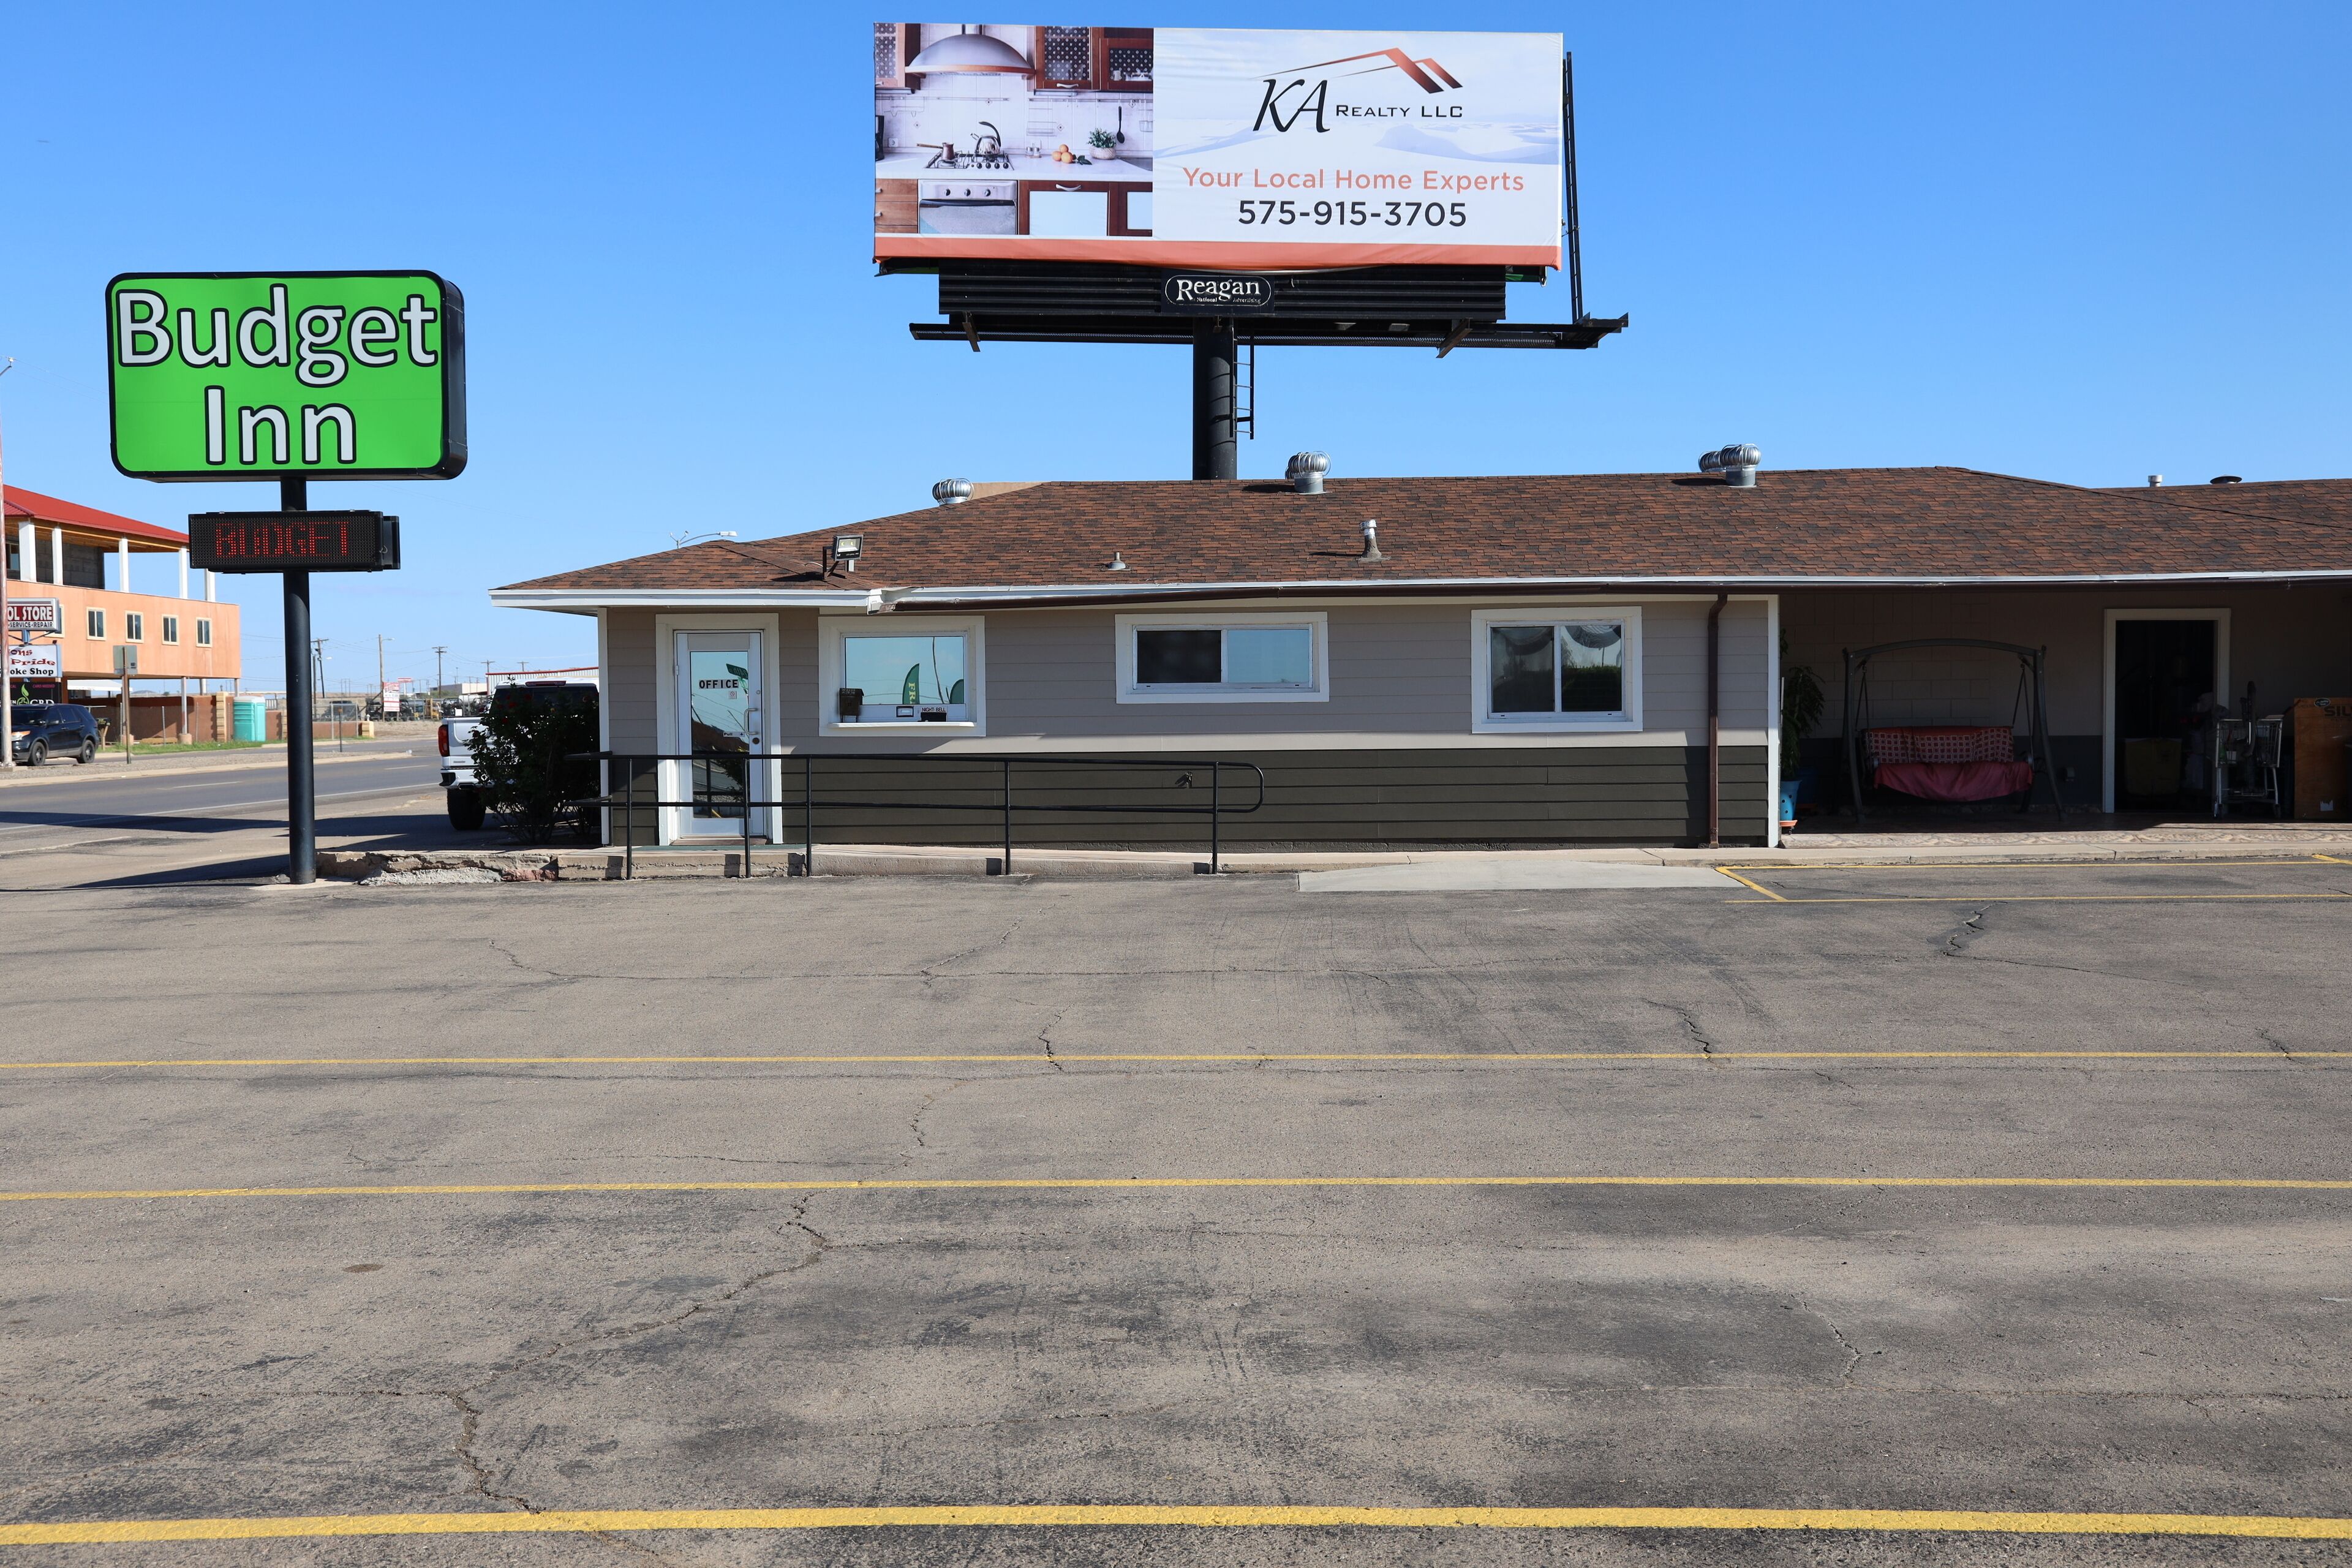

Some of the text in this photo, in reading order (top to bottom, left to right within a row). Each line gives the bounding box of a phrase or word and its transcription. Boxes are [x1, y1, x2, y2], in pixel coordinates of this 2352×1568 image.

[1253, 79, 1330, 133] KA
[1421, 105, 1463, 118] LLC
[1183, 167, 1525, 194] Your Local Home Experts
[1238, 200, 1466, 227] 575-915-3705
[1176, 279, 1261, 301] Reagan
[116, 284, 439, 388] Budget
[204, 385, 357, 465] Inn
[216, 521, 350, 558] BUDGET
[7, 606, 53, 621] OL STORE
[29, 668, 54, 676] Shop
[699, 679, 739, 689] OFFICE
[2324, 705, 2352, 717] SIL
